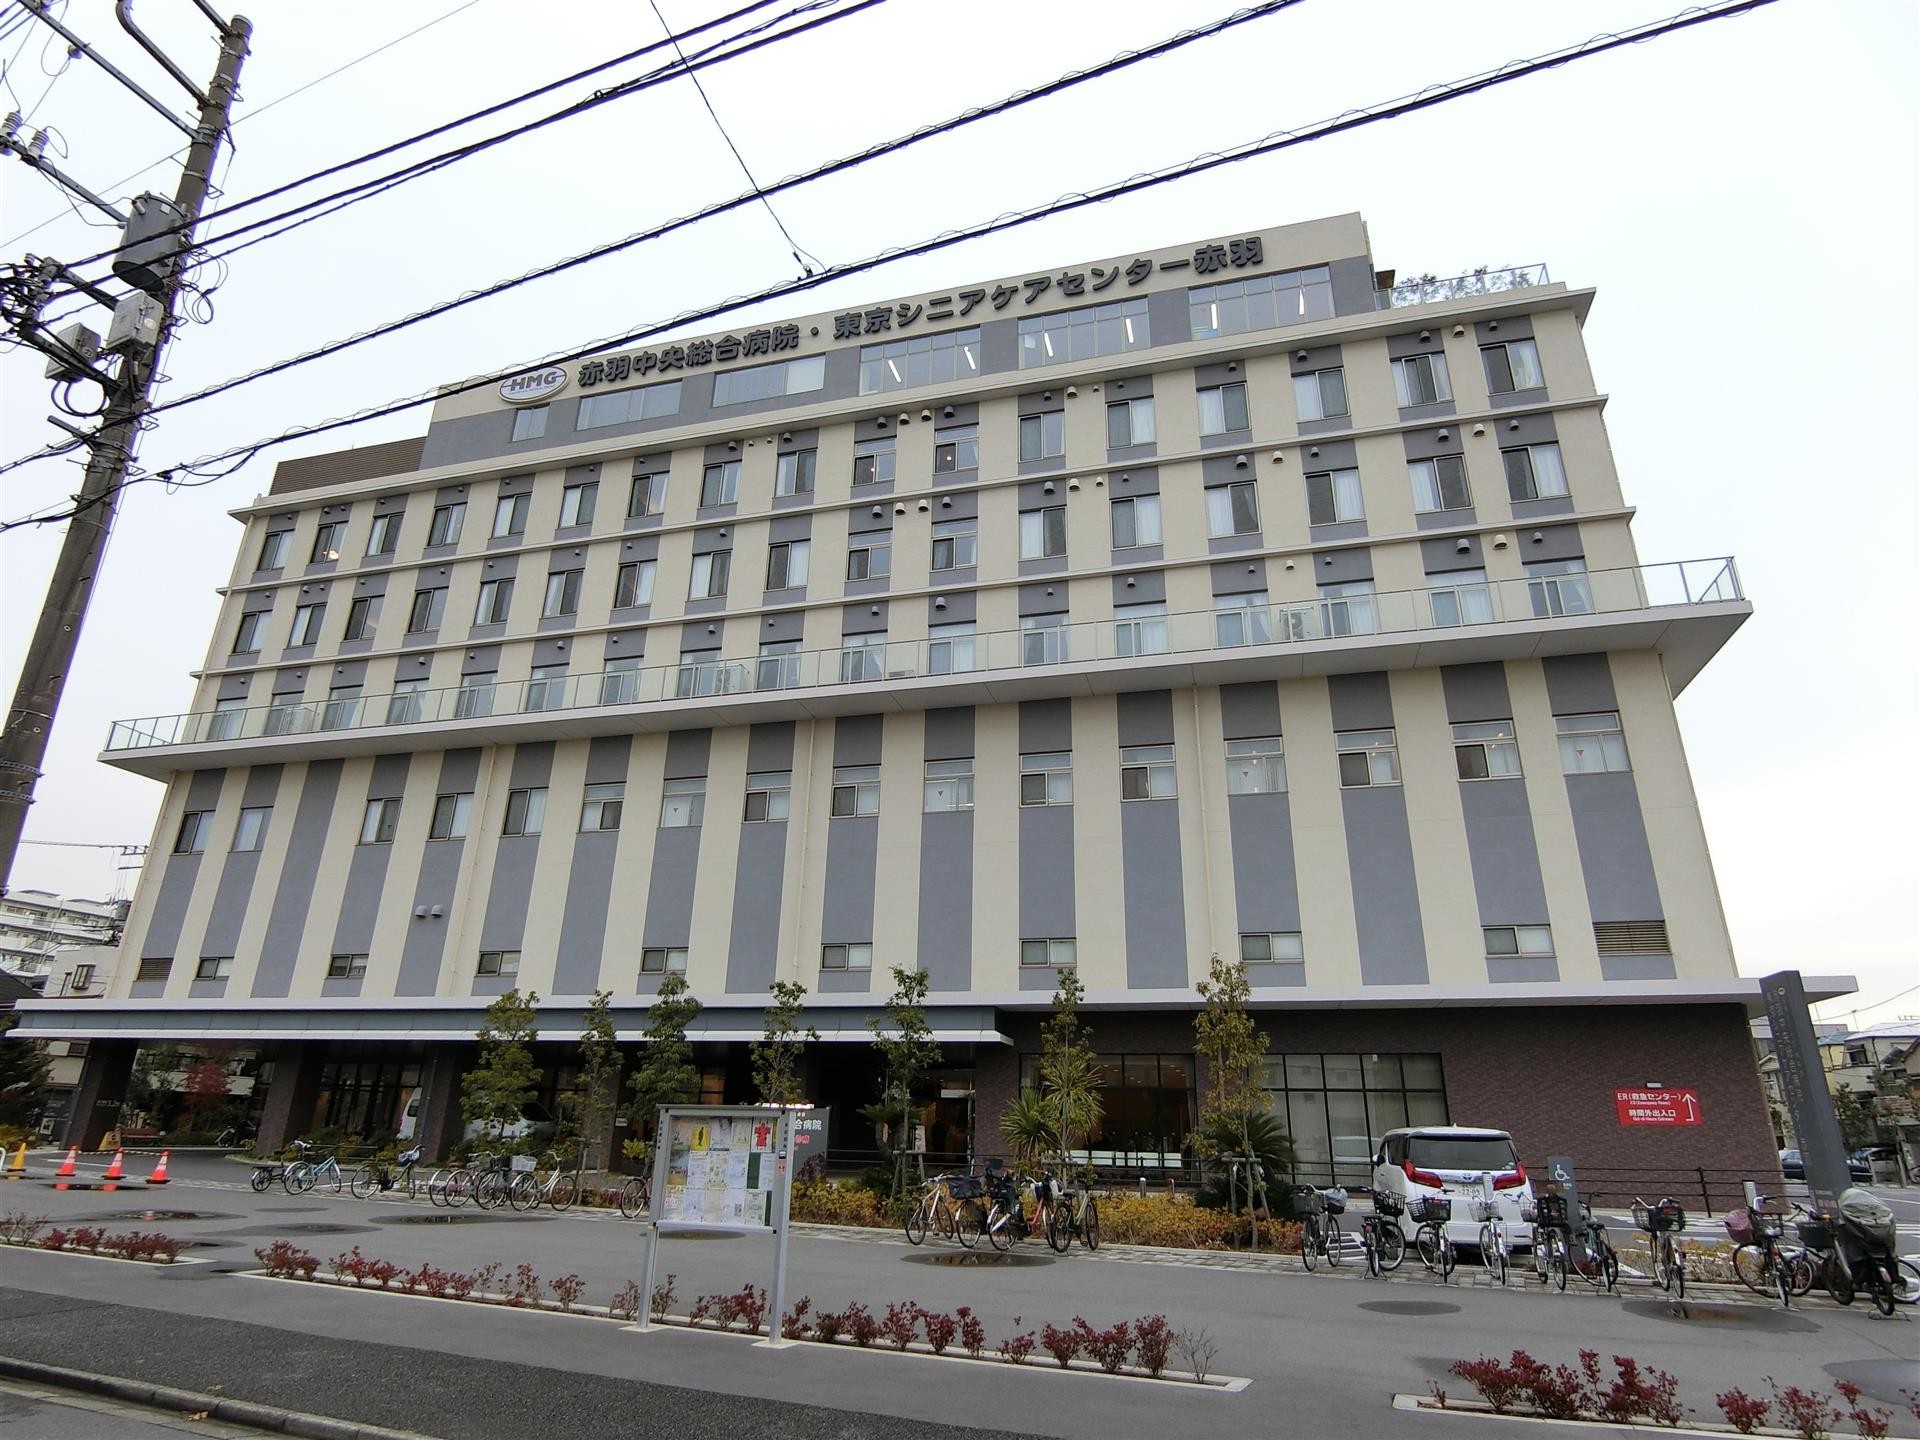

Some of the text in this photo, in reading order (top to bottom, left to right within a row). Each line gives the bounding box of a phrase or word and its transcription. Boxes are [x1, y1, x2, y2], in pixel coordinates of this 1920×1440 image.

[577, 236, 1264, 387] 赤羽中央総合病院・東京シニアケアセンター赤羽
[511, 371, 557, 392] HMG
[1628, 1109, 1676, 1117] 時間外出入口
